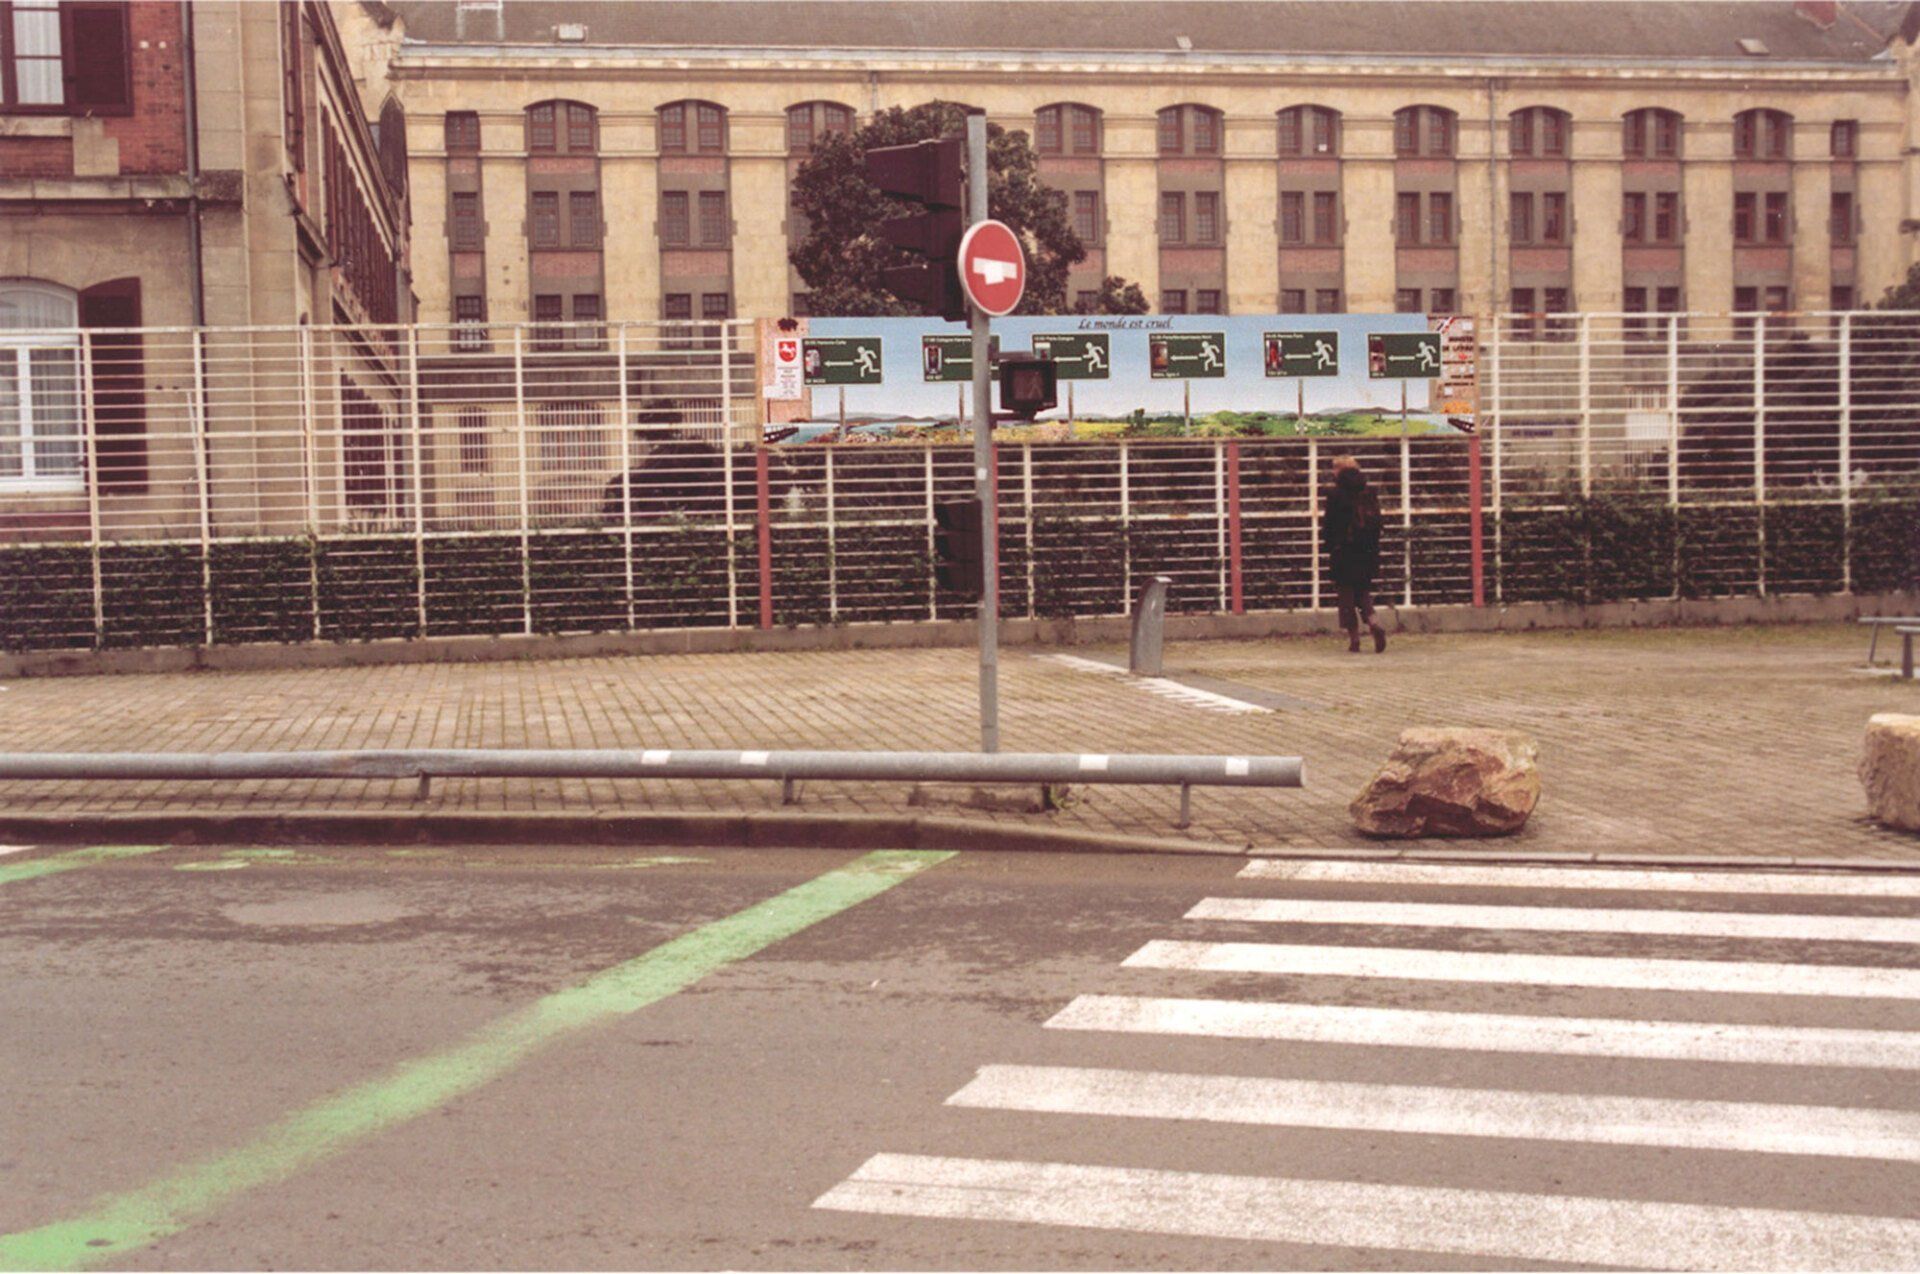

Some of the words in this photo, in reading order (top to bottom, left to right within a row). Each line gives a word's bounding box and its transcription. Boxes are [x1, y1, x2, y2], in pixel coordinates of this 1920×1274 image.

[1078, 318, 1091, 329] Le
[1094, 316, 1127, 329] monde
[1128, 319, 1143, 329] est
